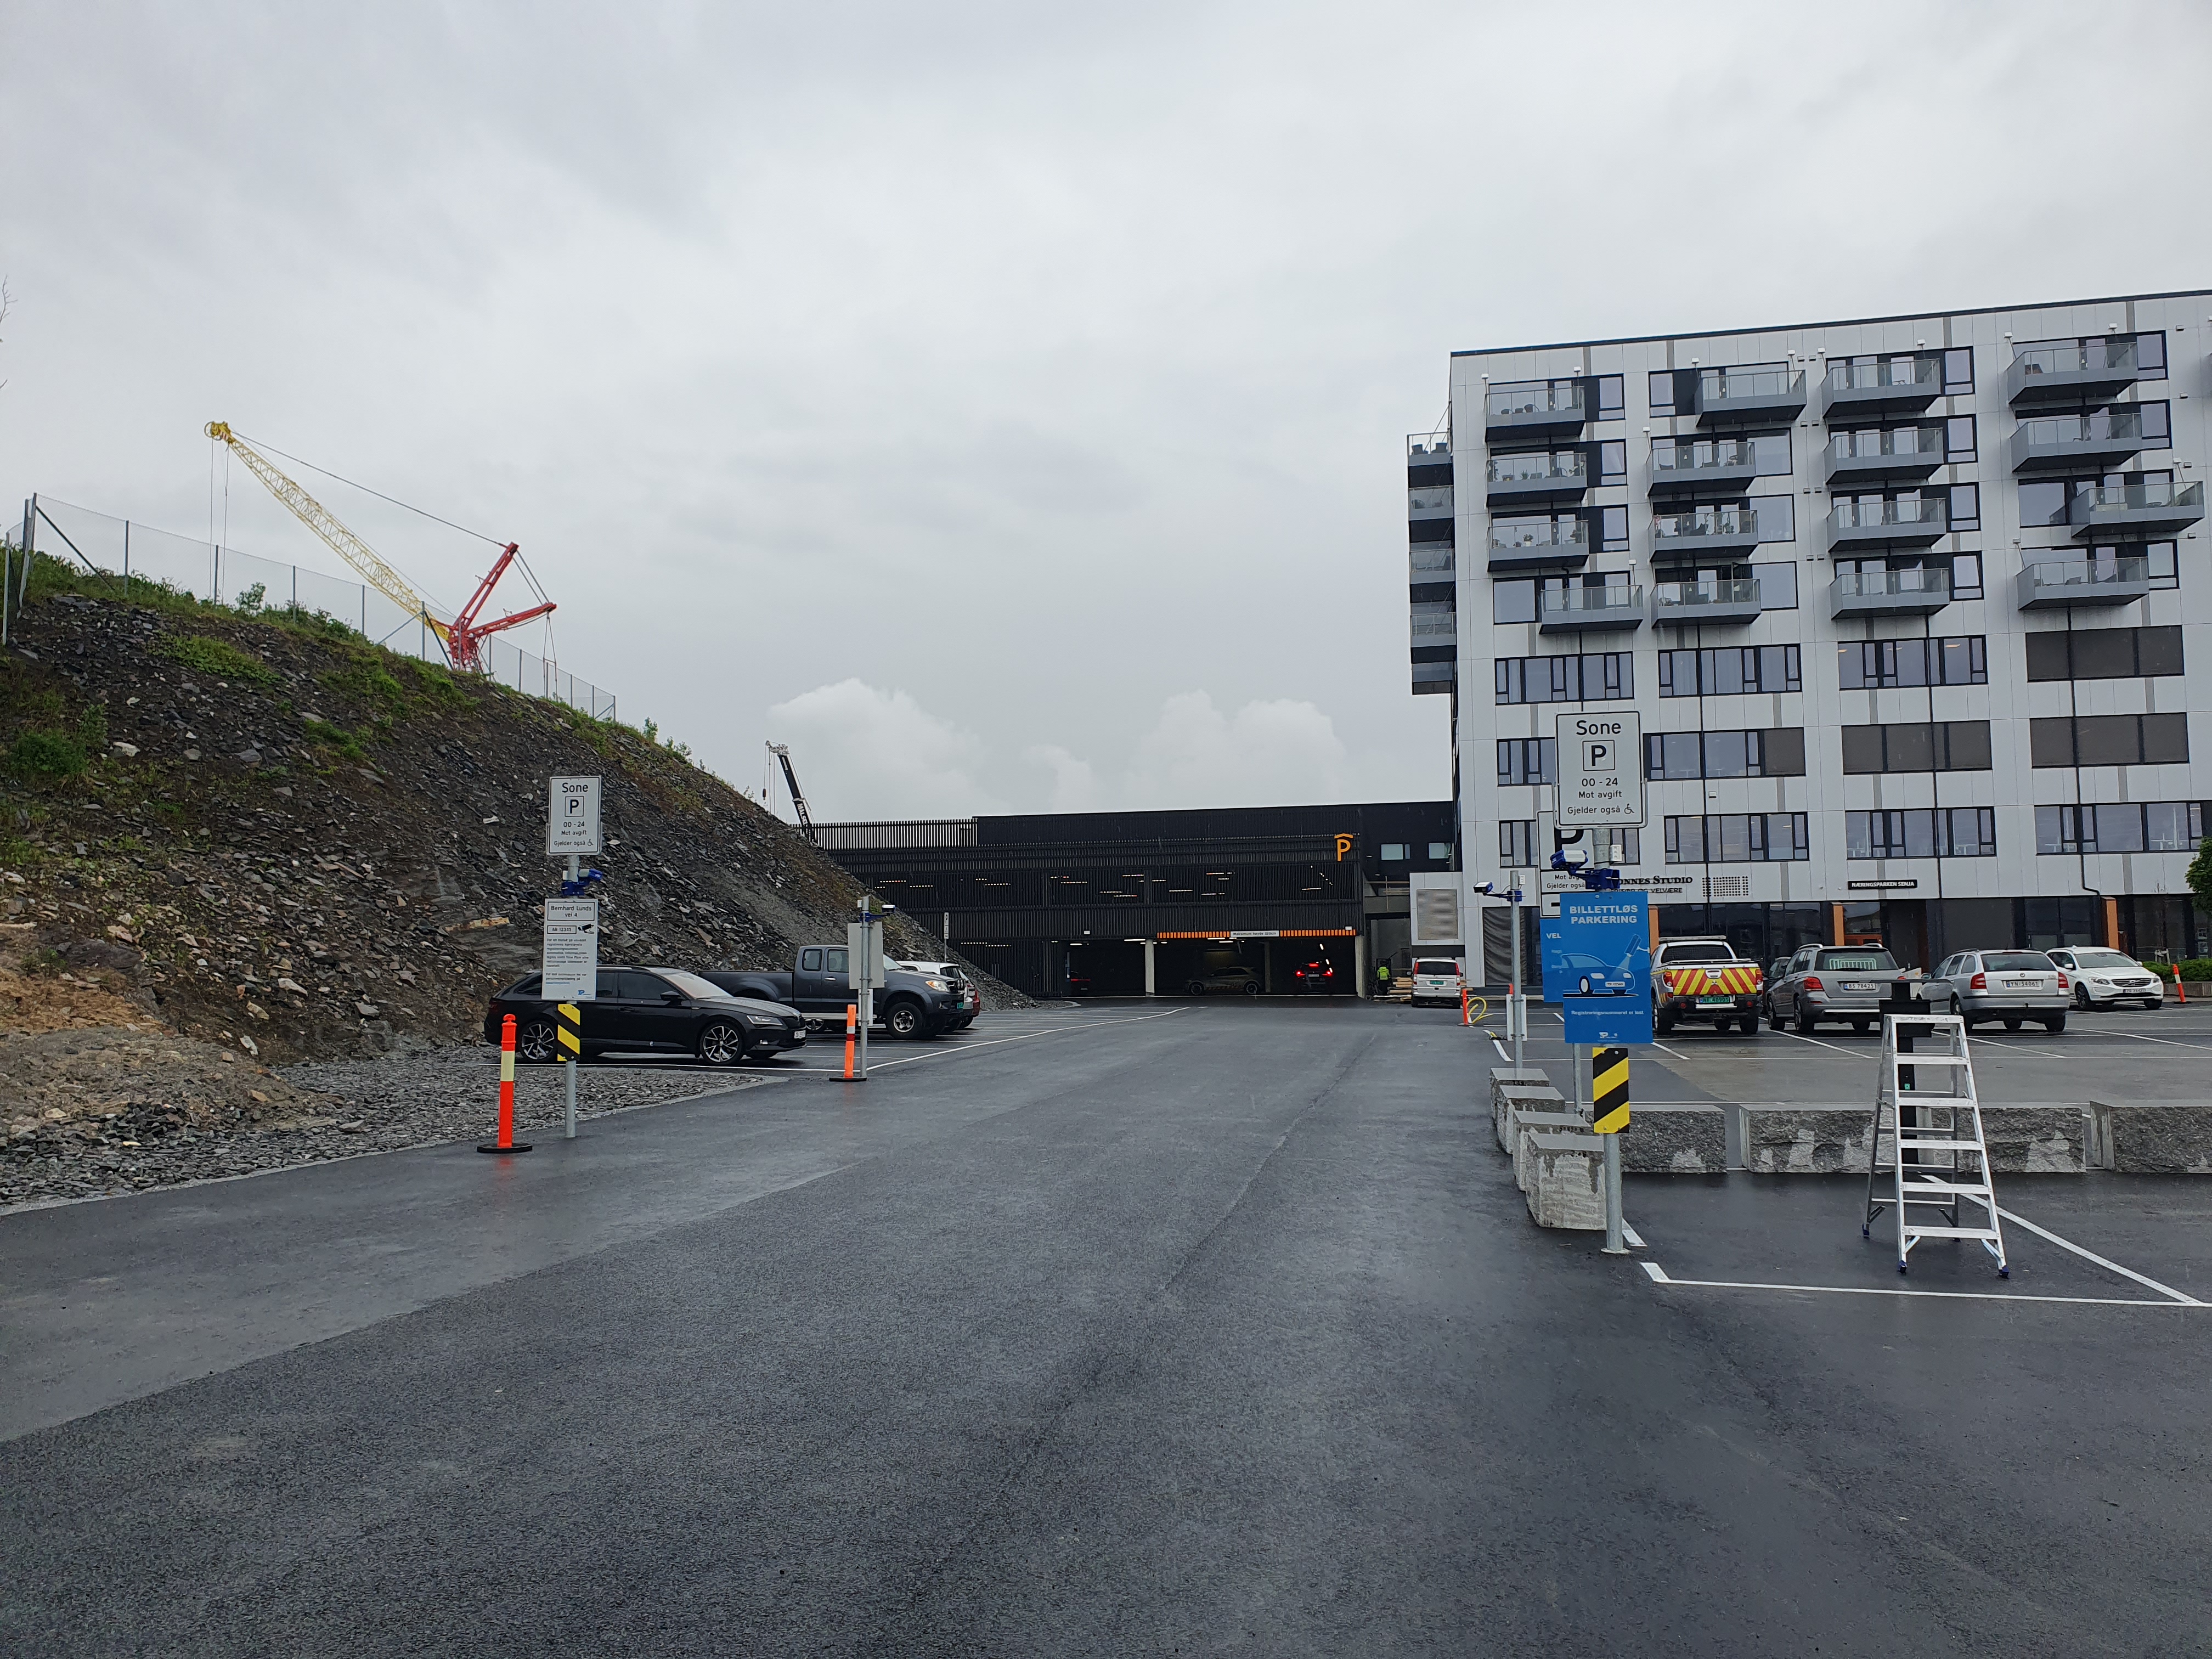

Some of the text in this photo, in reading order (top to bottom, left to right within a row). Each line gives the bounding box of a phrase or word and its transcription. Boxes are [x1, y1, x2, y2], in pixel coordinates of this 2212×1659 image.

[1576, 720, 1622, 736] Sone
[1591, 744, 1607, 766] P
[561, 782, 589, 793] Sone
[1582, 778, 1595, 787] 00
[1605, 777, 1618, 786] 24
[1578, 790, 1622, 799] Mot avgift
[569, 799, 579, 814] P
[1567, 805, 1621, 816] Gjelder også
[1337, 839, 1351, 861] P
[1570, 905, 1638, 914] BILLETTLØS
[1571, 915, 1638, 924] PARKERING
